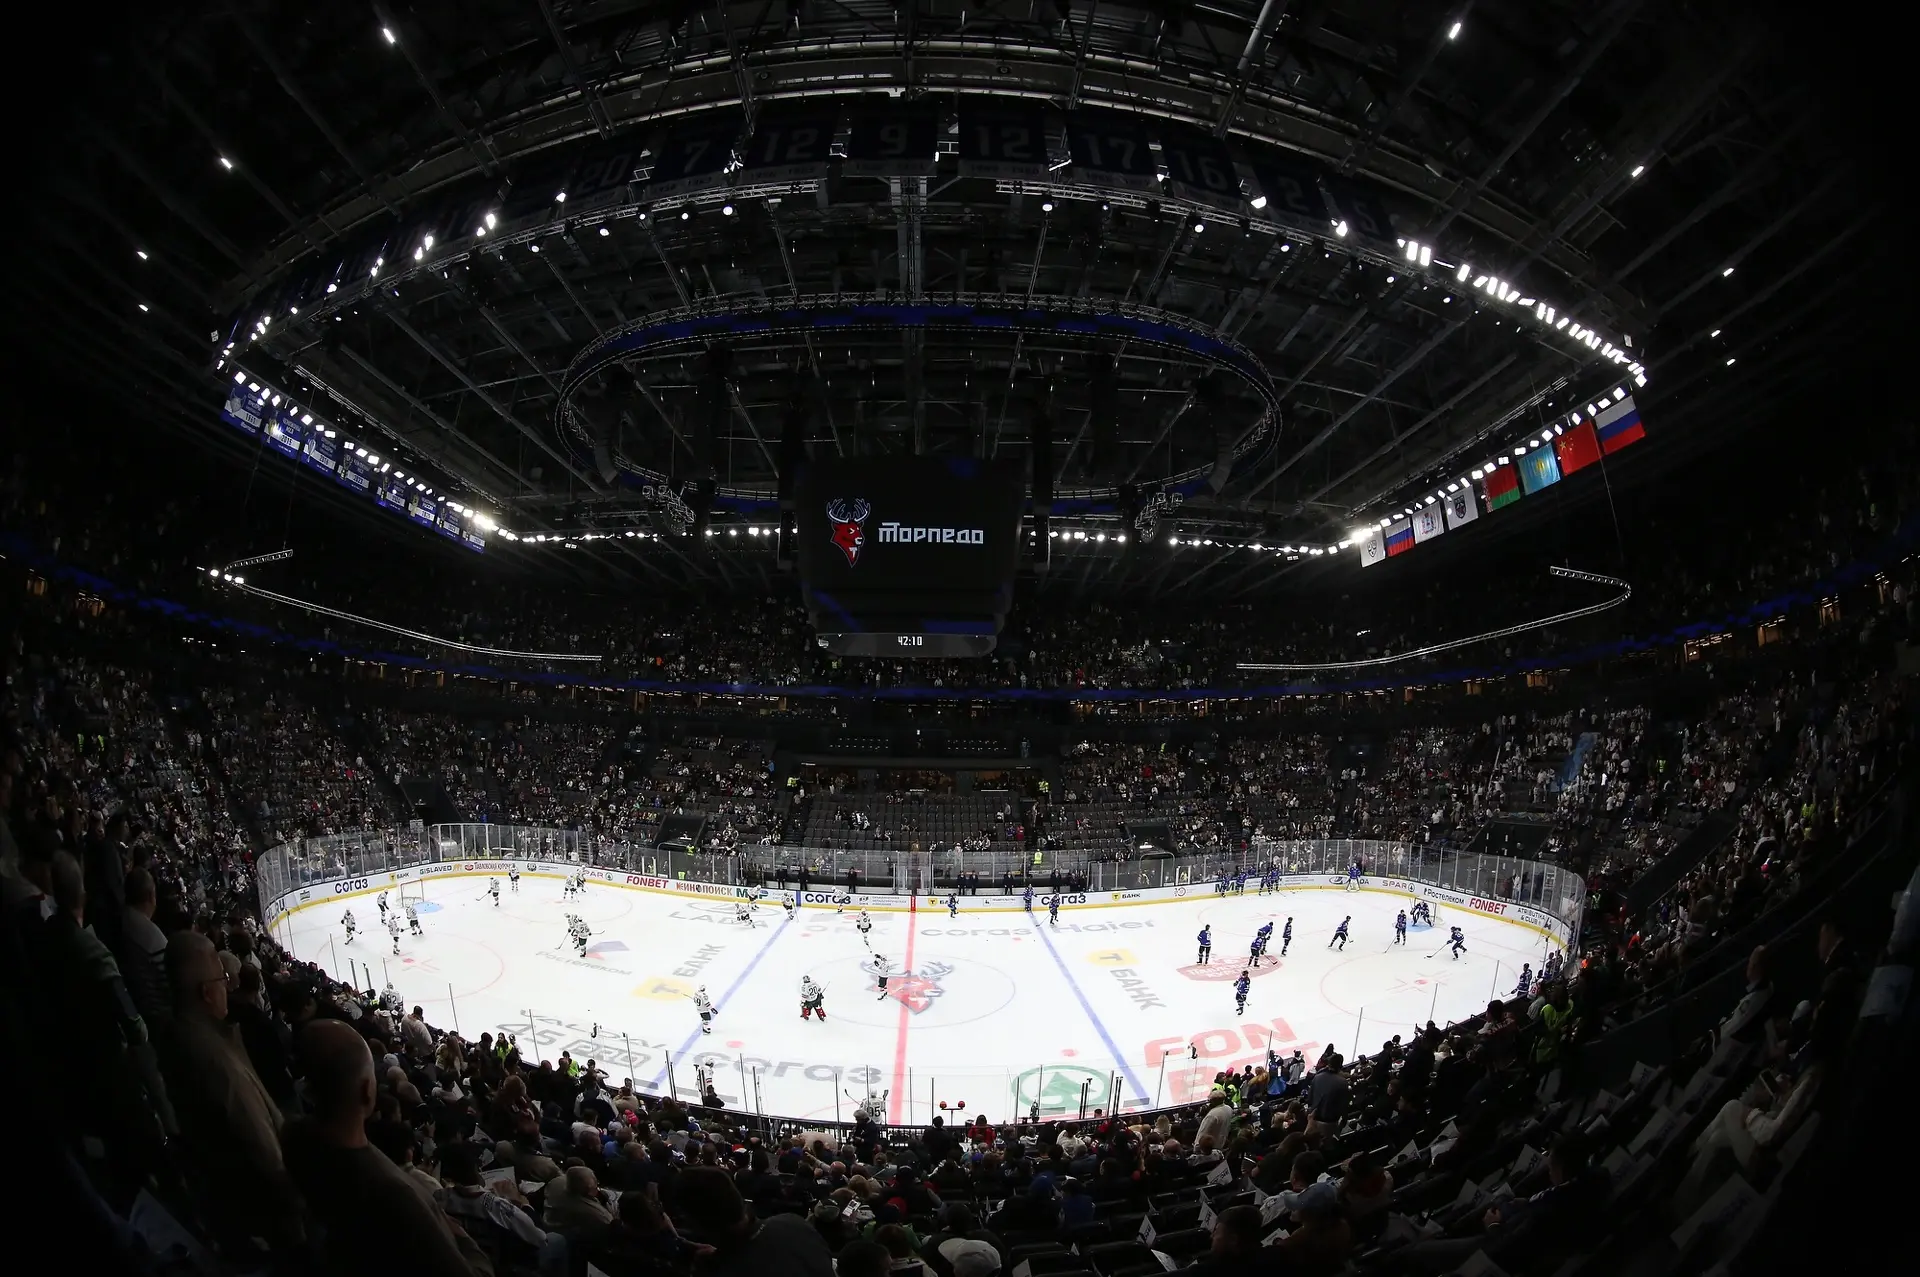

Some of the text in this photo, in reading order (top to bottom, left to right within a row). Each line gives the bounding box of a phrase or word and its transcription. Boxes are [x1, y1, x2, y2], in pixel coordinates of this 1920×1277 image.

[762, 127, 820, 163] 12
[879, 124, 908, 154] 9
[974, 125, 1034, 159] 12
[683, 138, 712, 175] 7
[1081, 132, 1138, 170] 17
[878, 522, 984, 545] Торпедо
[897, 635, 923, 646] 42:10
[420, 865, 452, 875] GISLAVED
[583, 870, 604, 879] PAR
[626, 875, 669, 889] FONBET
[1382, 880, 1407, 889] SPAR
[736, 887, 769, 900] МР
[1041, 893, 1087, 905] сгаз
[1428, 888, 1465, 905] Ростелеком
[1468, 897, 1508, 915] FONBET
[1050, 918, 1157, 934] Haier
[534, 950, 634, 977] Ростелеком
[671, 943, 728, 978] БАНК
[1109, 967, 1168, 1011] БАНК
[1143, 1016, 1298, 1068] FON
